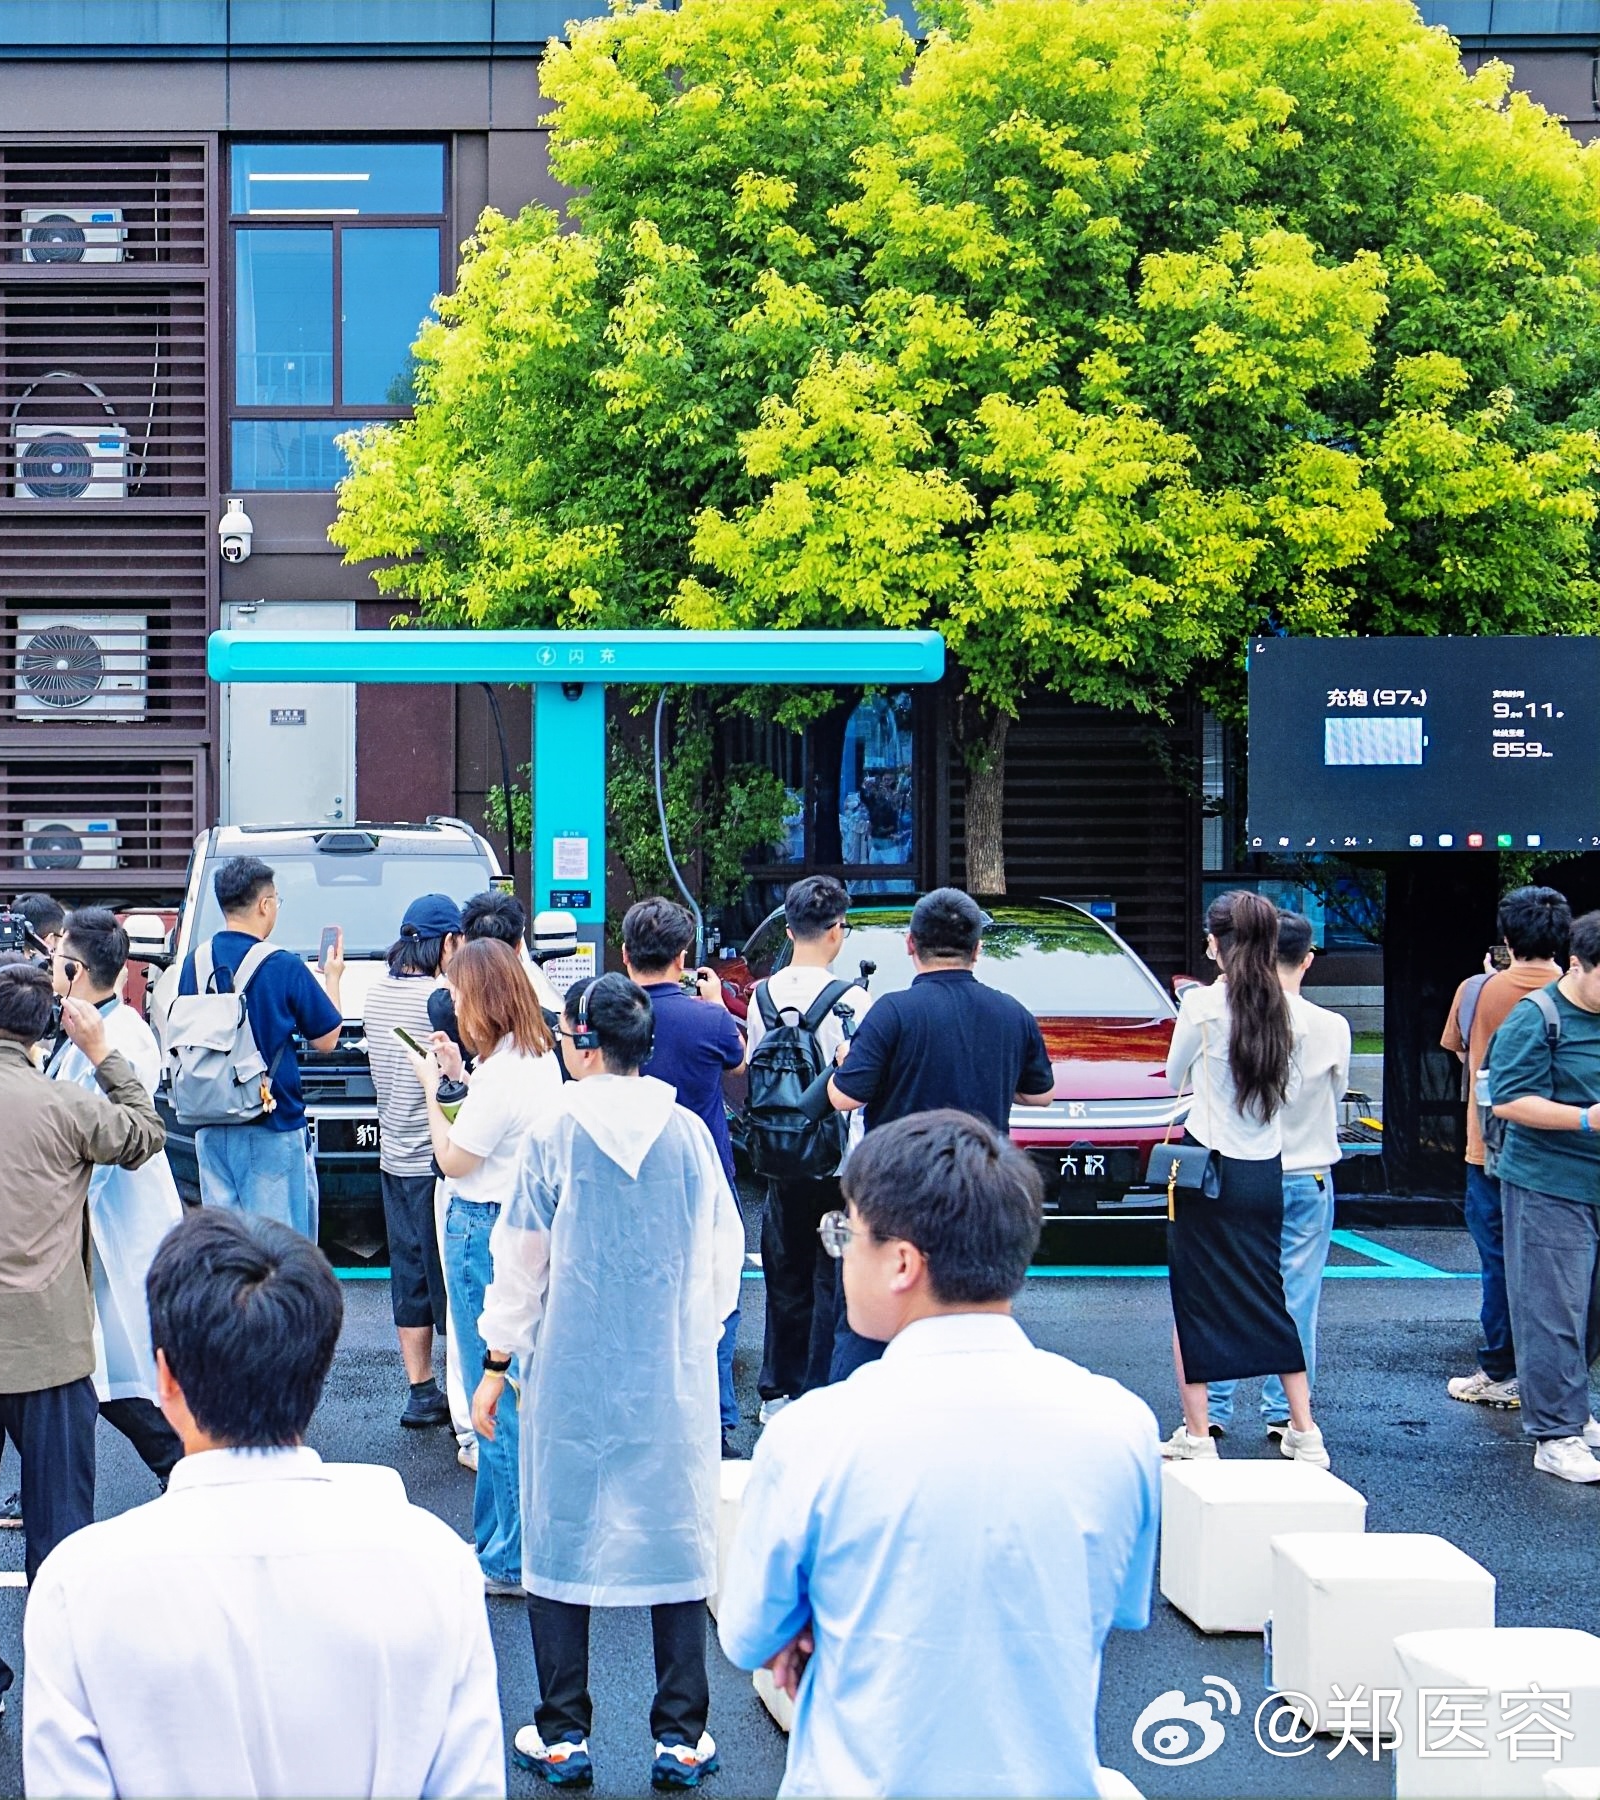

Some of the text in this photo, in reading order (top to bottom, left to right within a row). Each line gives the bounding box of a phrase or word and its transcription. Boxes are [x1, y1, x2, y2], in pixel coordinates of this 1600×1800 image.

[568, 648, 616, 665] 闪充
[1326, 688, 1369, 707] 充饱
[356, 1124, 381, 1147] 豹
[1059, 1154, 1105, 1176] 大汉
